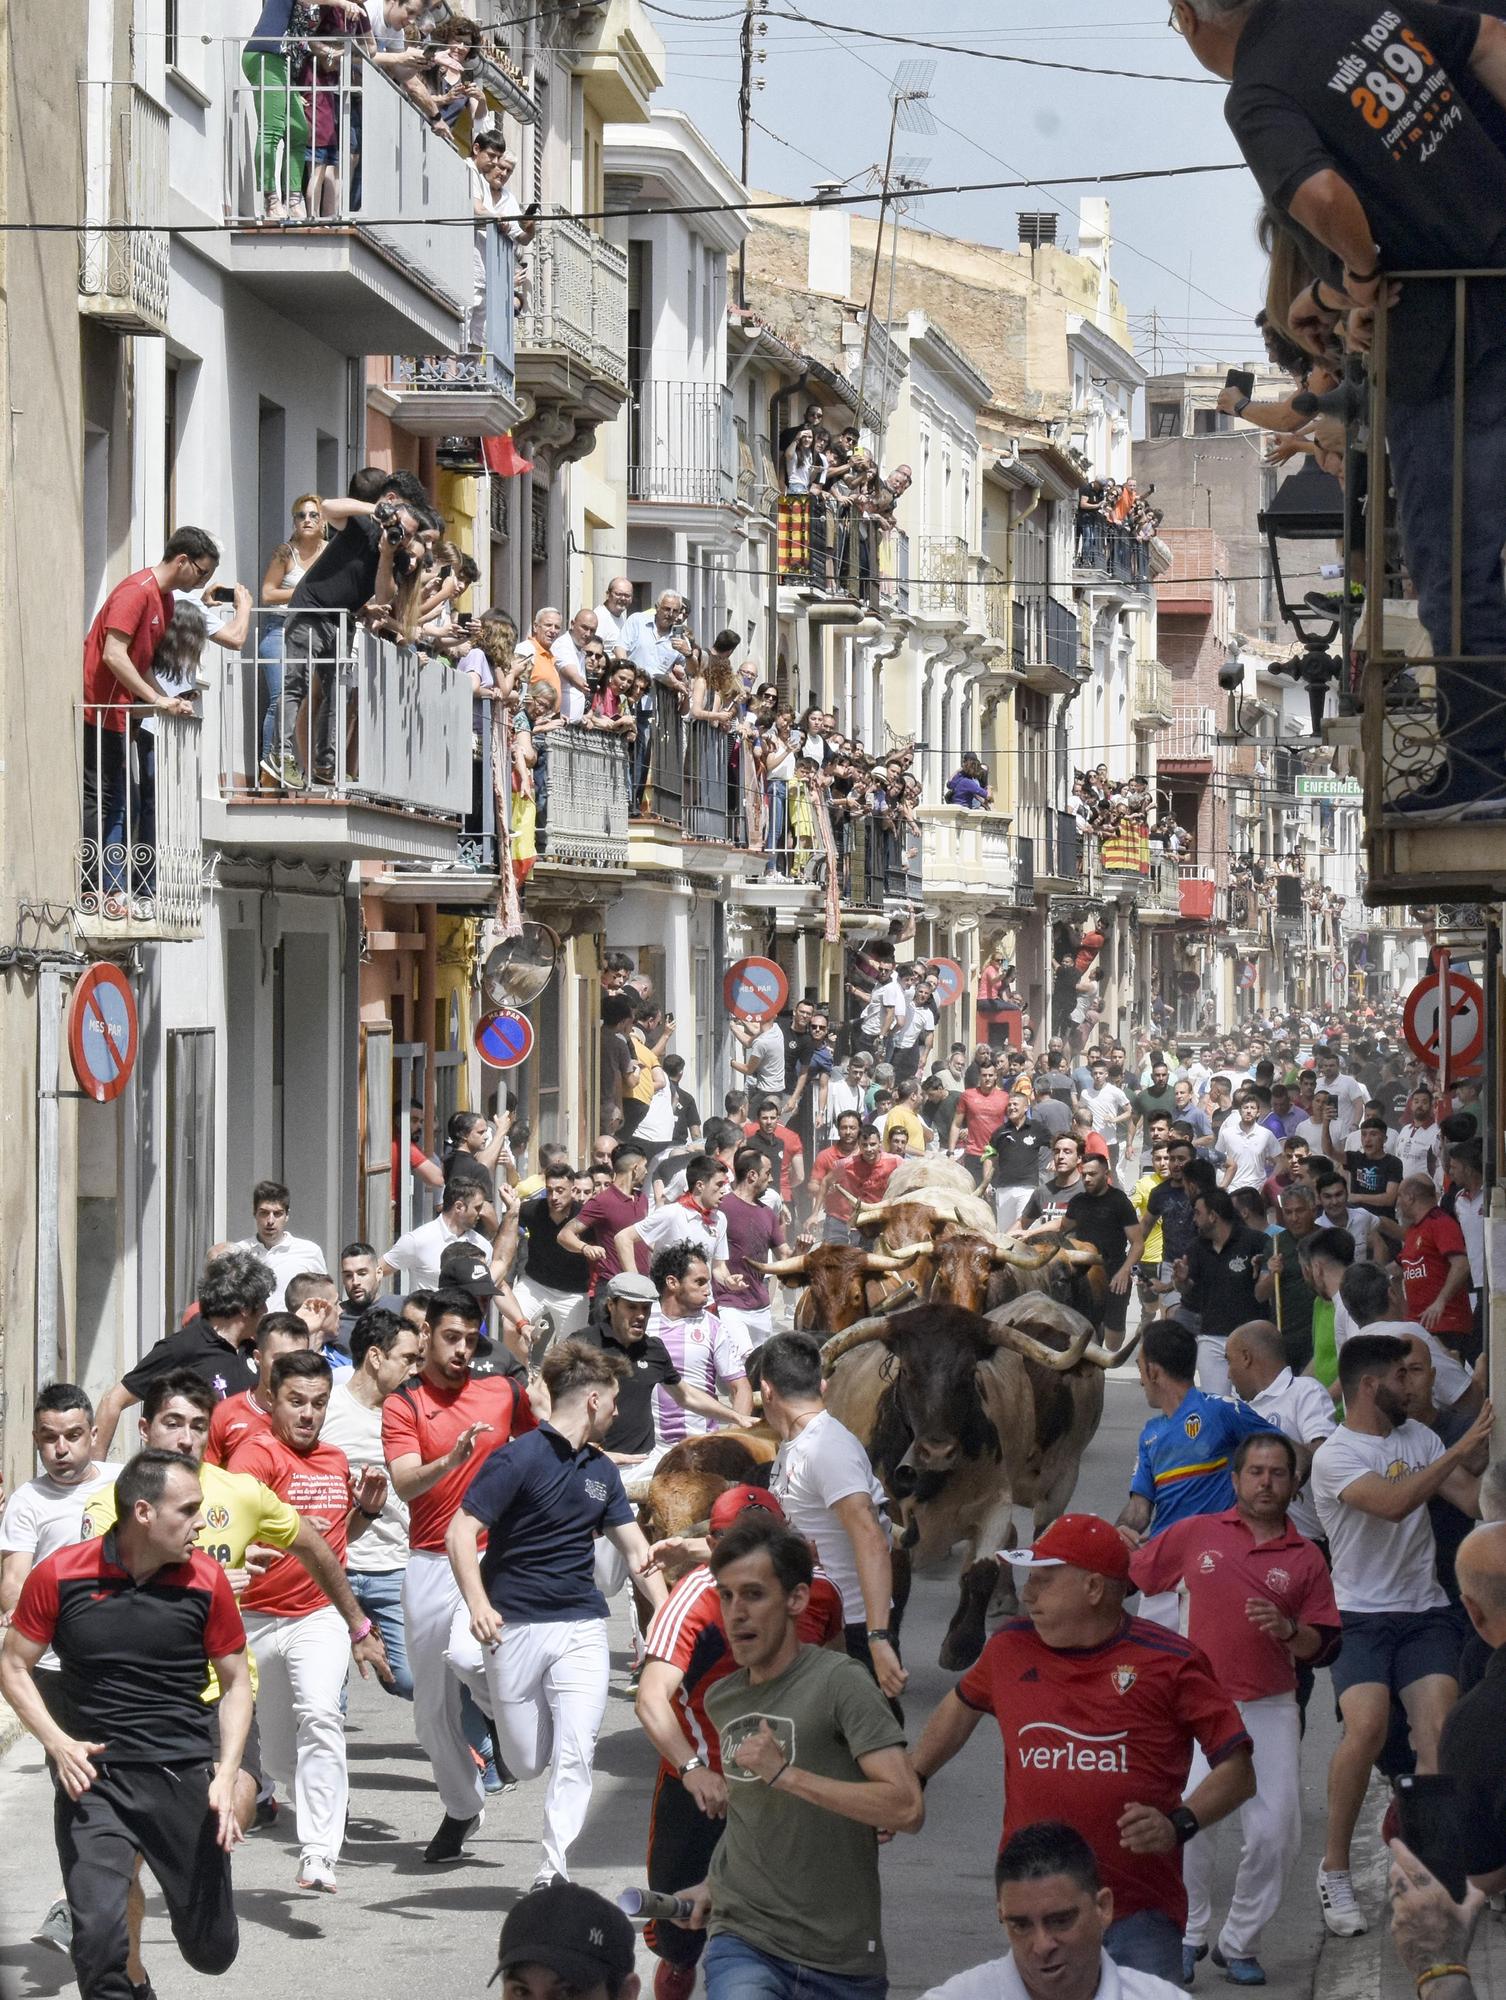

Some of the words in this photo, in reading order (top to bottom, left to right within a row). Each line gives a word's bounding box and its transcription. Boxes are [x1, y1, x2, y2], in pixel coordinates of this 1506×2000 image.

[1328, 54, 1367, 93] vuits
[1361, 11, 1401, 52] nous
[1387, 111, 1417, 144] cartes
[88, 1018, 105, 1034] MES
[107, 1022, 122, 1037] PAR
[506, 1010, 521, 1021] PAR
[1018, 1742, 1129, 1773] verleal
